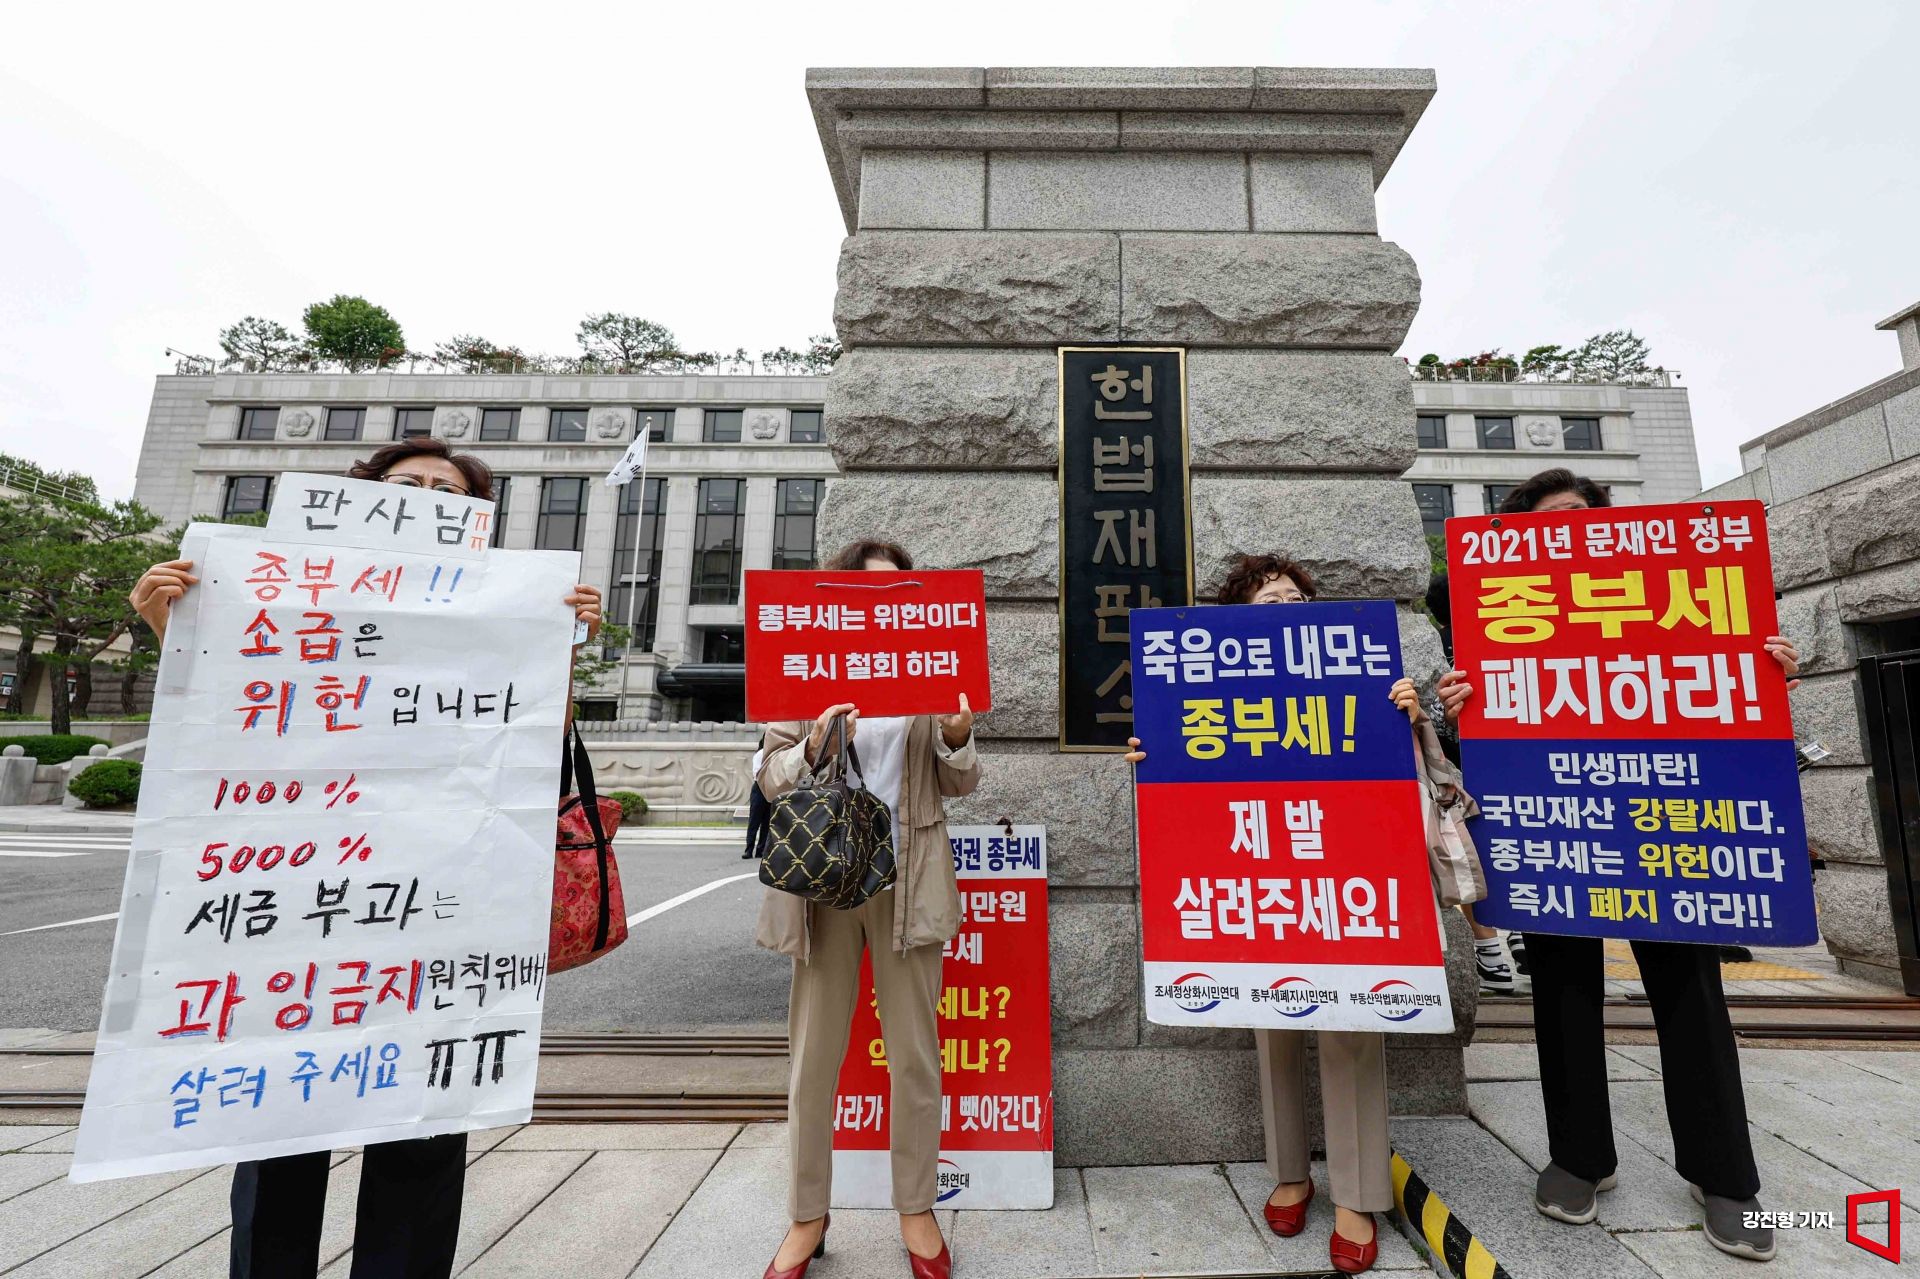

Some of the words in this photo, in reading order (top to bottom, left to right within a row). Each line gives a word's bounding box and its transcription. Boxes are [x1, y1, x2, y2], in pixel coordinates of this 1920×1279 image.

[1461, 524, 1572, 565] 2021년
[1585, 518, 1677, 557] 문재인
[1688, 516, 1753, 553] 정부
[758, 604, 865, 632] 종부세는
[874, 603, 978, 630] 위헌이다
[1477, 566, 1751, 644] 종부세
[239, 608, 383, 663] 소급은
[1142, 628, 1275, 684] 죽음으로
[1284, 624, 1391, 680] 내모는
[783, 654, 836, 681] 즉시
[845, 652, 898, 680] 철회
[906, 651, 959, 677] 하라
[1480, 653, 1762, 725] 폐지하라!
[1549, 751, 1698, 787] 민생파탄!
[1482, 795, 1615, 830] 국민재산
[1628, 798, 1785, 834] 강탈세다.
[987, 837, 1040, 872] 종부세
[1489, 838, 1624, 876] 종부세는
[1638, 843, 1785, 883] 위헌이다
[185, 888, 278, 943] 세금
[302, 876, 461, 938] 부과는
[960, 890, 1027, 923] 만원
[1173, 877, 1400, 941] 살려주세요!
[1509, 883, 1574, 920] 즉시
[1589, 888, 1659, 924] 폐지
[1672, 891, 1773, 929] 하라!!
[1154, 985, 1240, 1000] 조세정상화시민연대
[1250, 988, 1339, 1004] 종부세폐지시민연대
[1349, 992, 1442, 1007] 부동산악법폐지시민연대
[959, 1095, 1041, 1132] 뺏아간다
